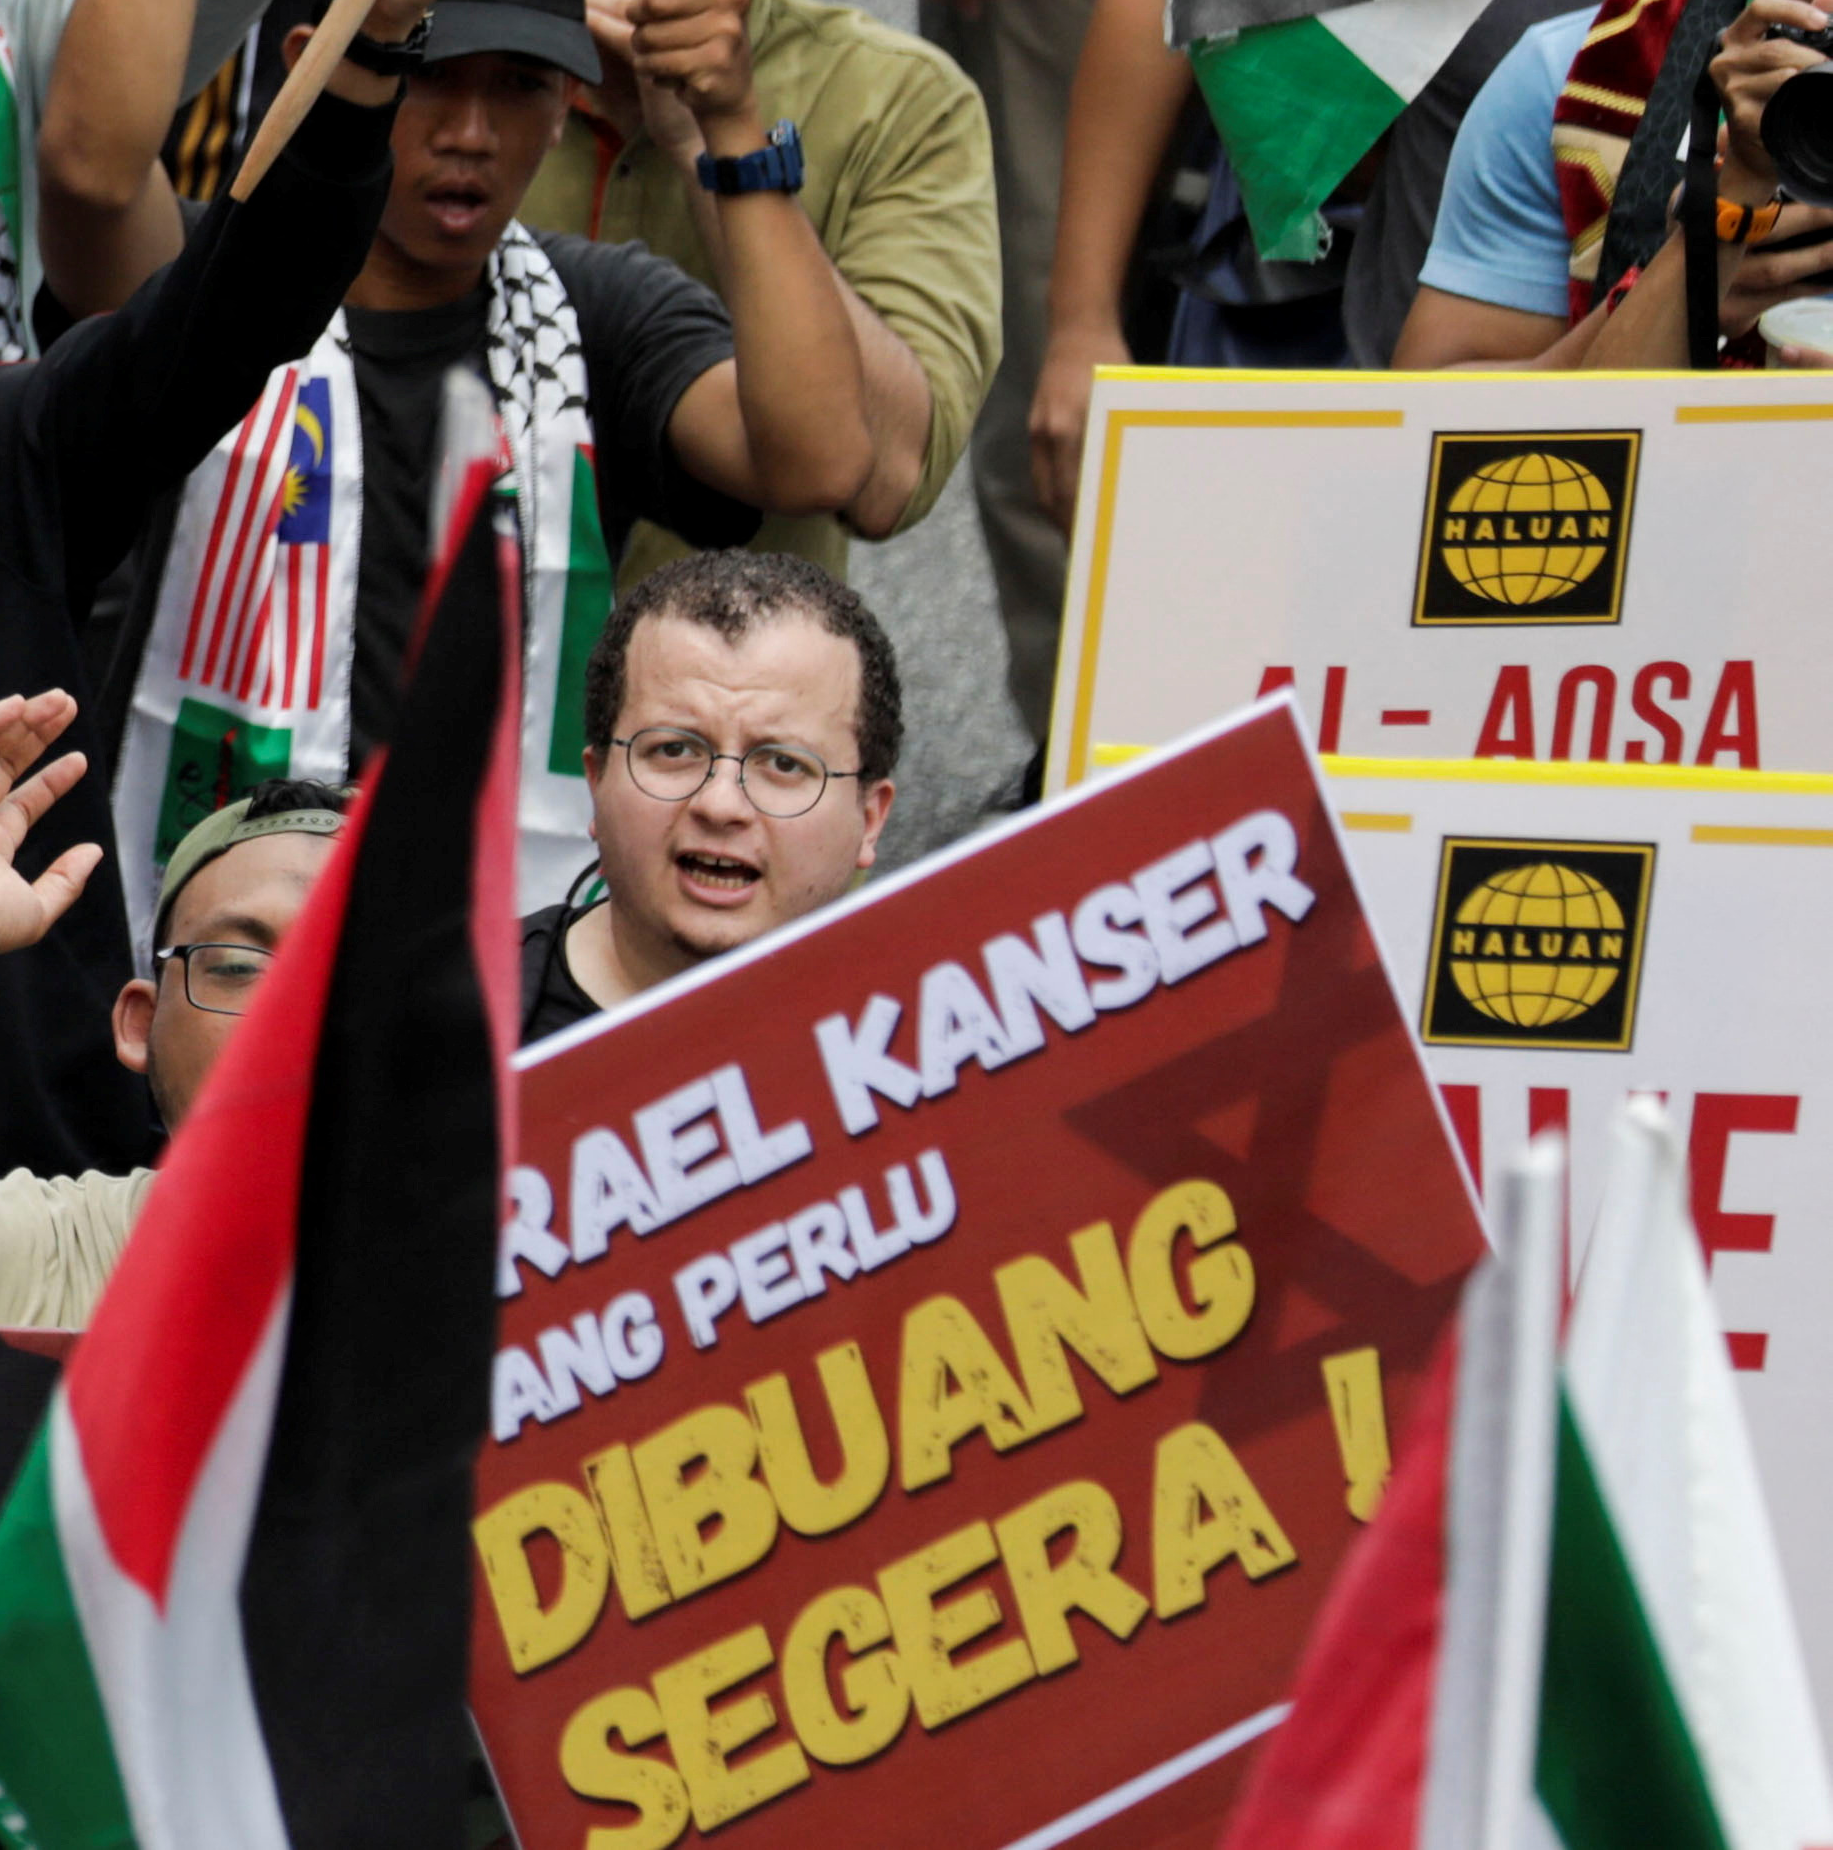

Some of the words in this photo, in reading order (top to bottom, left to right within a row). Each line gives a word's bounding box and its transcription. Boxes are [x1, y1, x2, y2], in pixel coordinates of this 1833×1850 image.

[1445, 516, 1610, 542] HALUAN
[500, 1064, 811, 1299] RAEL
[813, 809, 1317, 1137] KANSER
[1452, 929, 1623, 960] HALUAN
[471, 1178, 1256, 1676] DIBUANG
[493, 1290, 665, 1442] ANG
[673, 1150, 959, 1347] PERLU
[559, 1421, 1297, 1850] SEGERA
